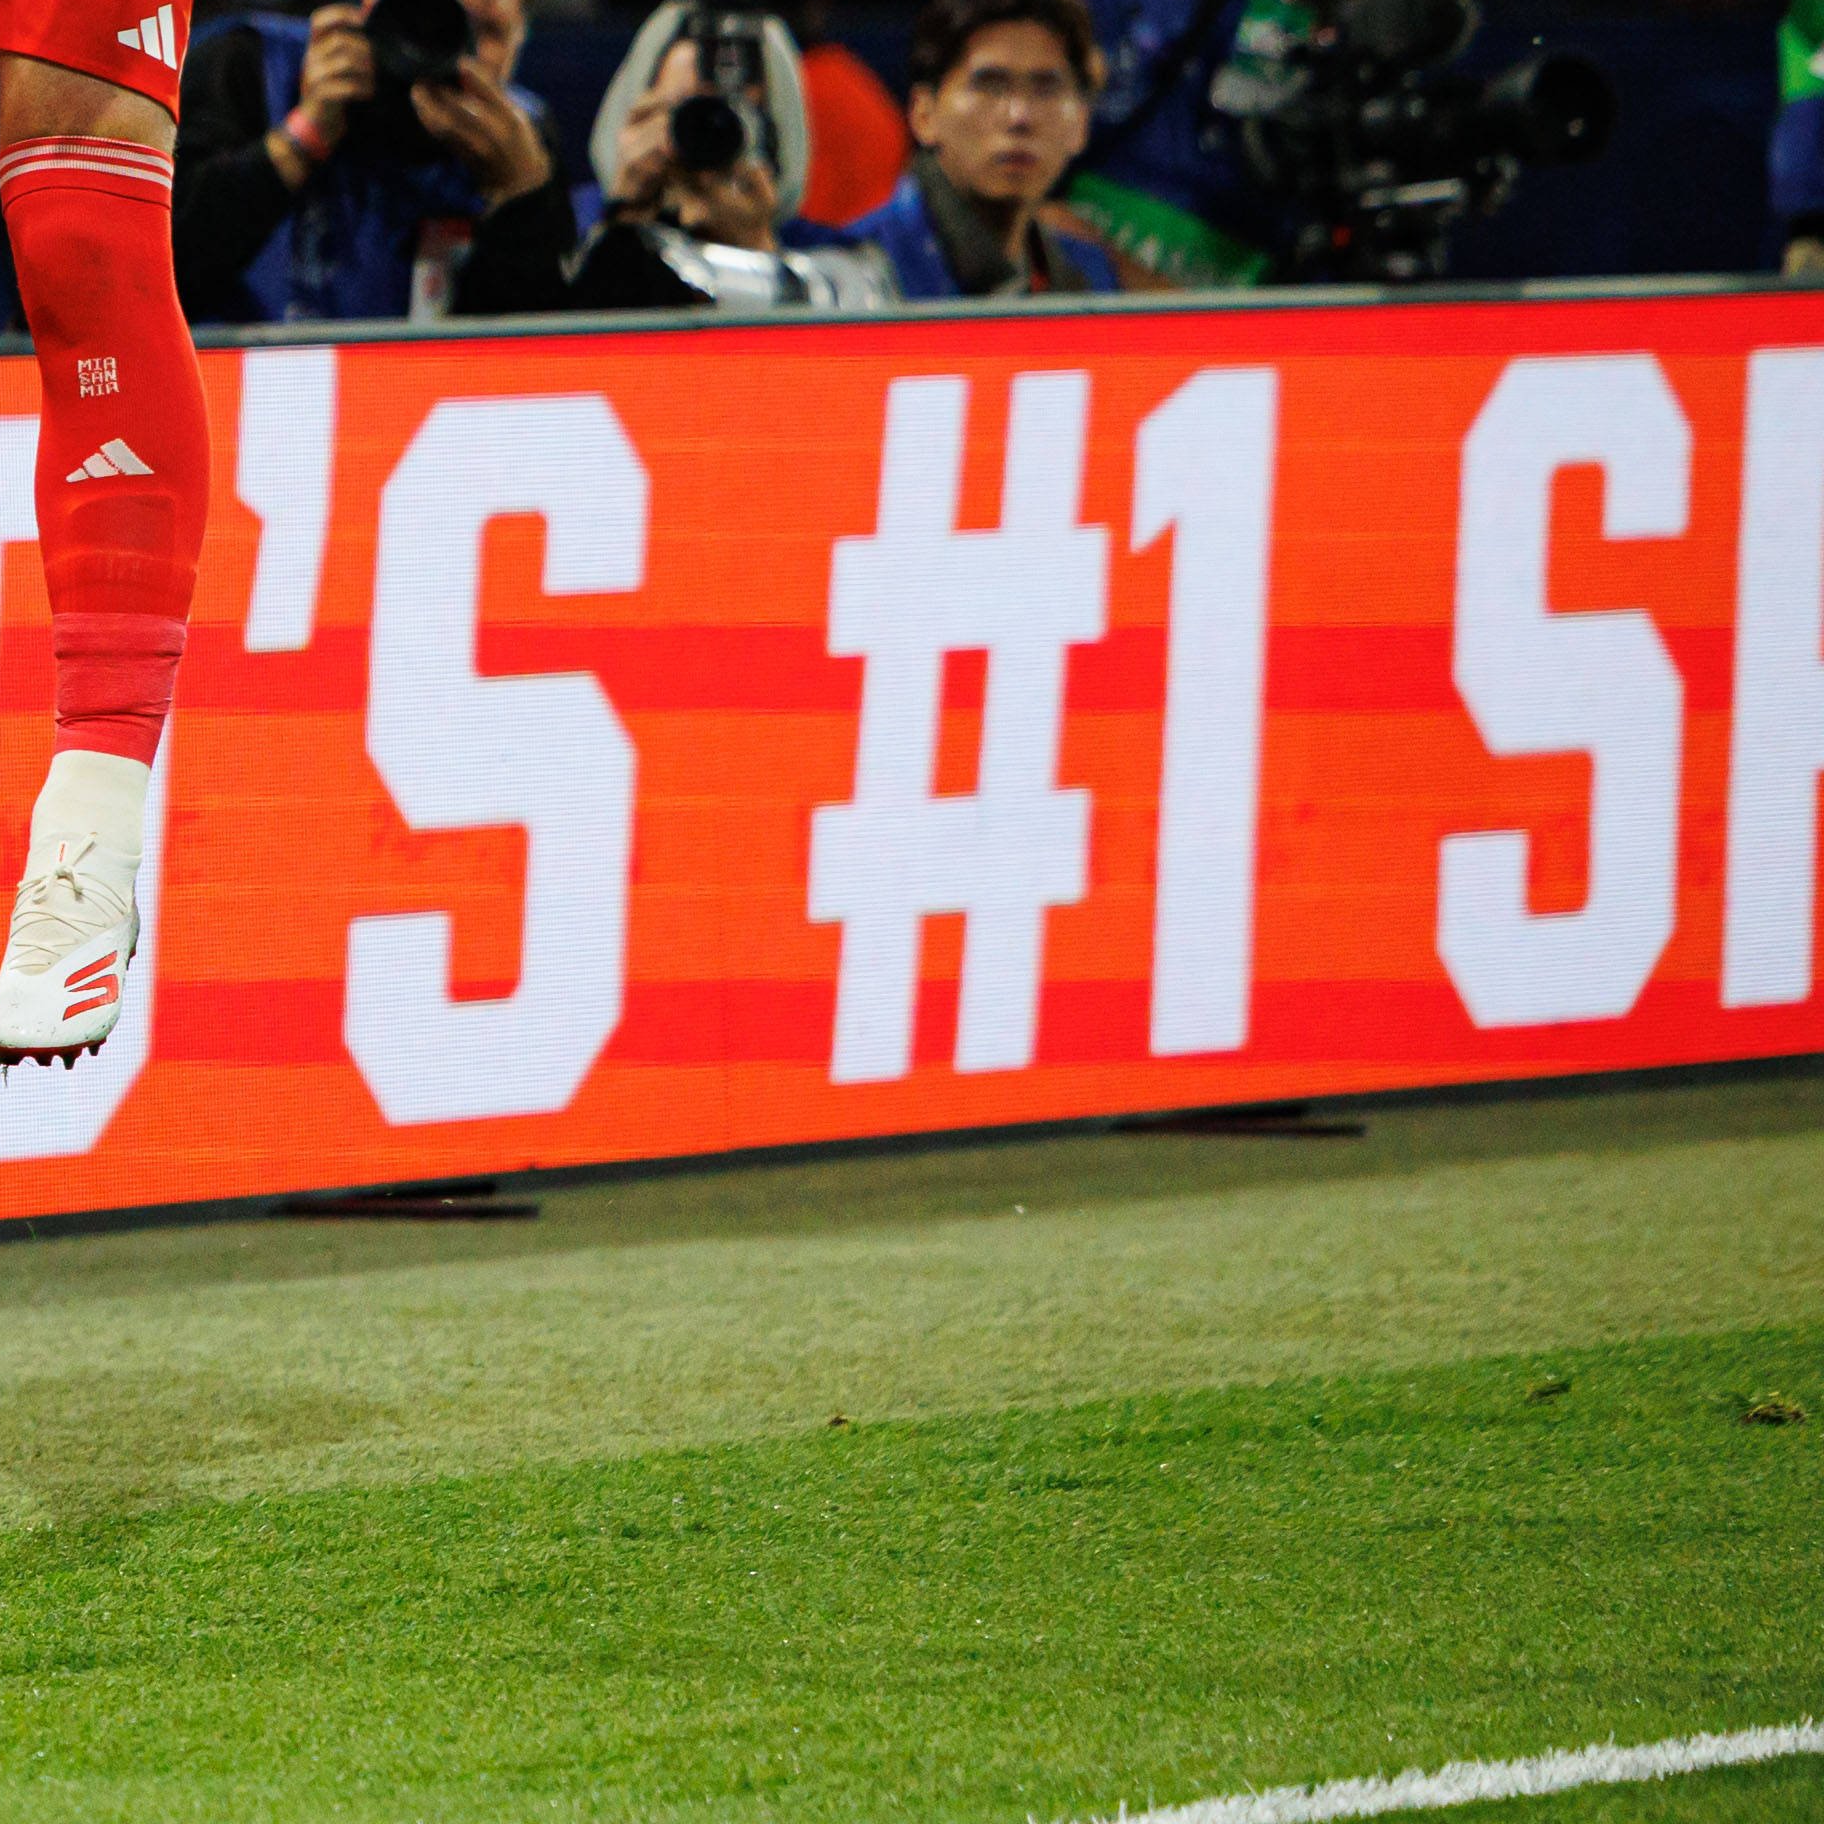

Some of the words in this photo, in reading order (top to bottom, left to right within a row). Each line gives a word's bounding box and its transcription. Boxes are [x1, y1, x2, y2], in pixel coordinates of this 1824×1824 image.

[77, 356, 117, 373] MIA
[78, 369, 117, 385] SAN
[80, 381, 120, 399] MIA
[808, 365, 1281, 1085] #1
